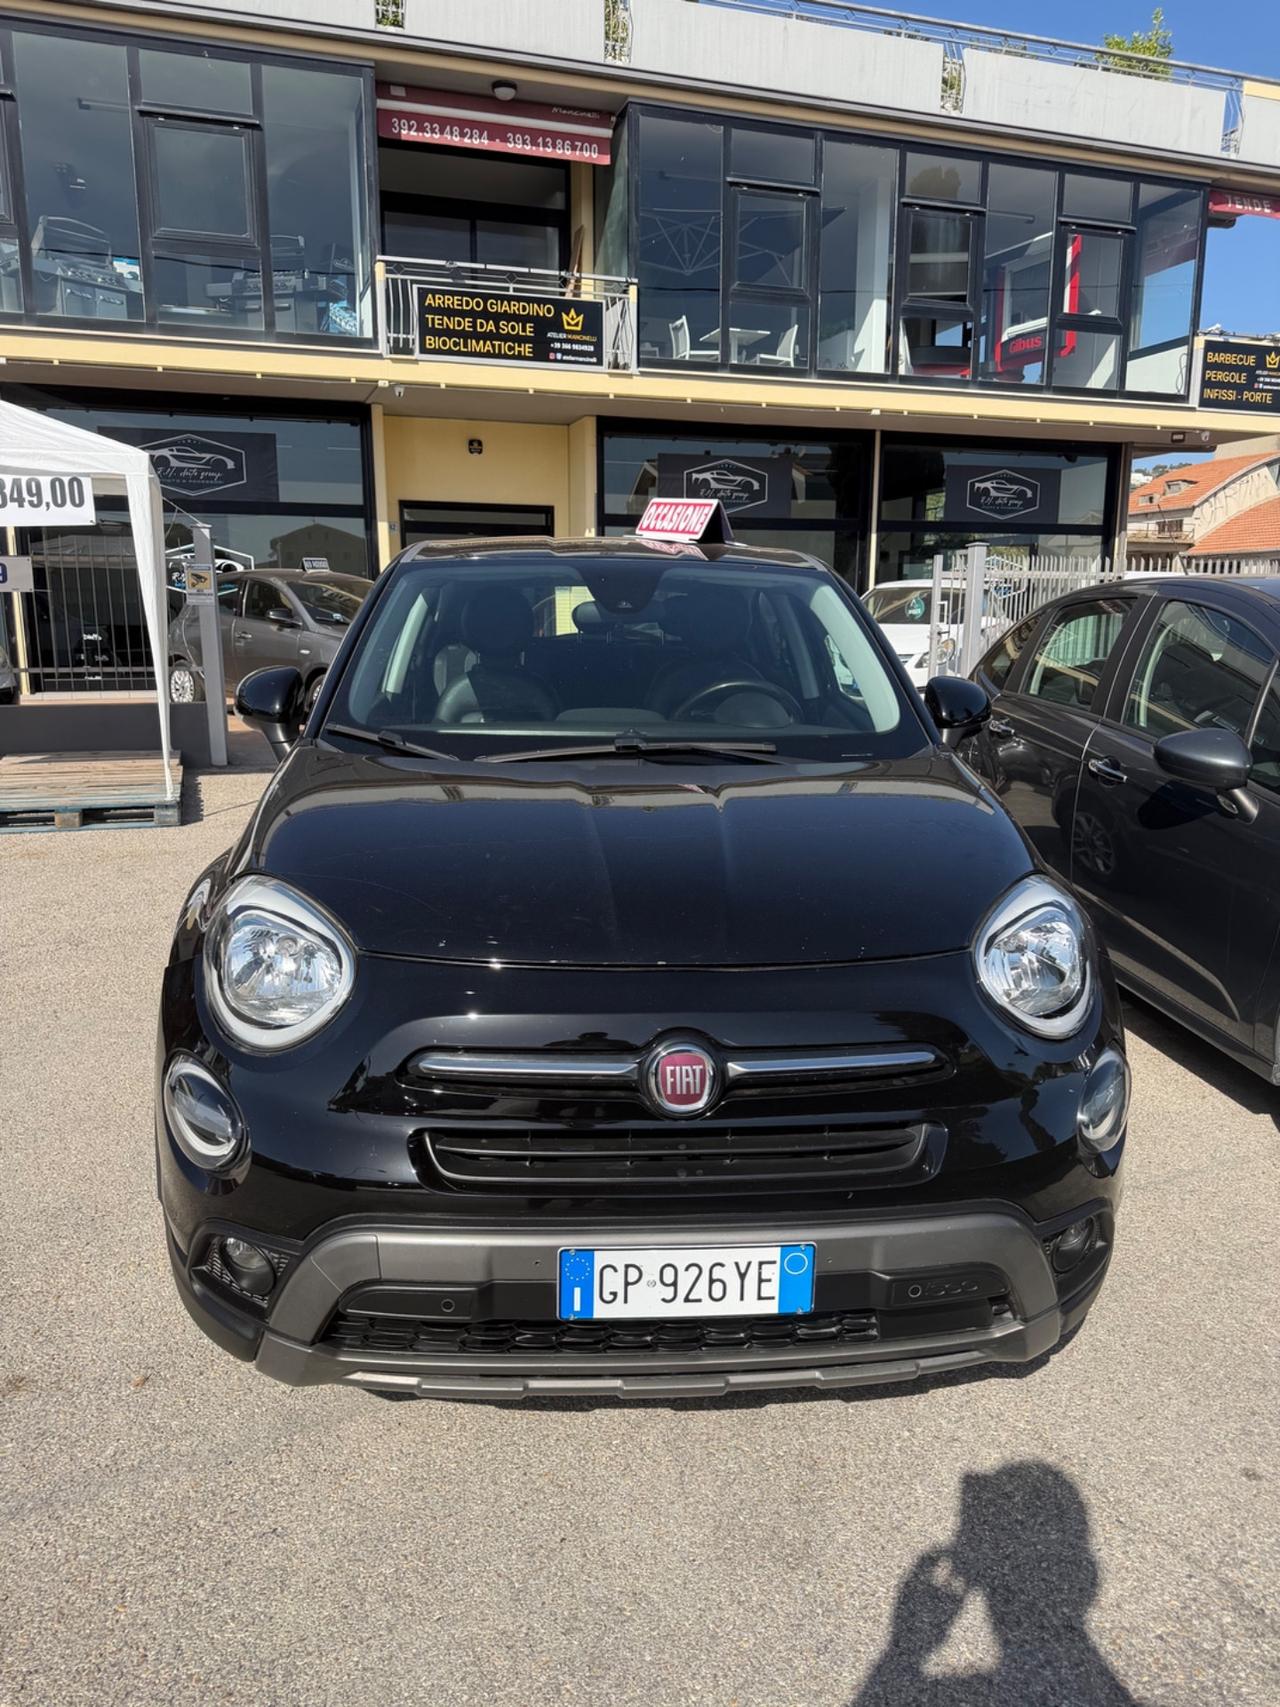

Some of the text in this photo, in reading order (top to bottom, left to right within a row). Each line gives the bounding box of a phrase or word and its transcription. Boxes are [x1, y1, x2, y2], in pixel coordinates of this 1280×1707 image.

[1226, 195, 1271, 213] TENDE
[425, 293, 555, 318] ARREDO GIARDINO
[426, 314, 535, 337] TENDE DA SOLE
[426, 336, 534, 357] BIOCLIMATICHE
[1206, 351, 1256, 367] BARBECUE
[1205, 370, 1247, 384] PERGOLE
[1203, 388, 1236, 401] INFISSI
[1242, 390, 1273, 404] PORTE
[641, 502, 713, 533] OCCASIONE
[665, 1065, 704, 1095] FIAT
[598, 1259, 777, 1305] GP 926YE
[573, 1287, 581, 1312] I
